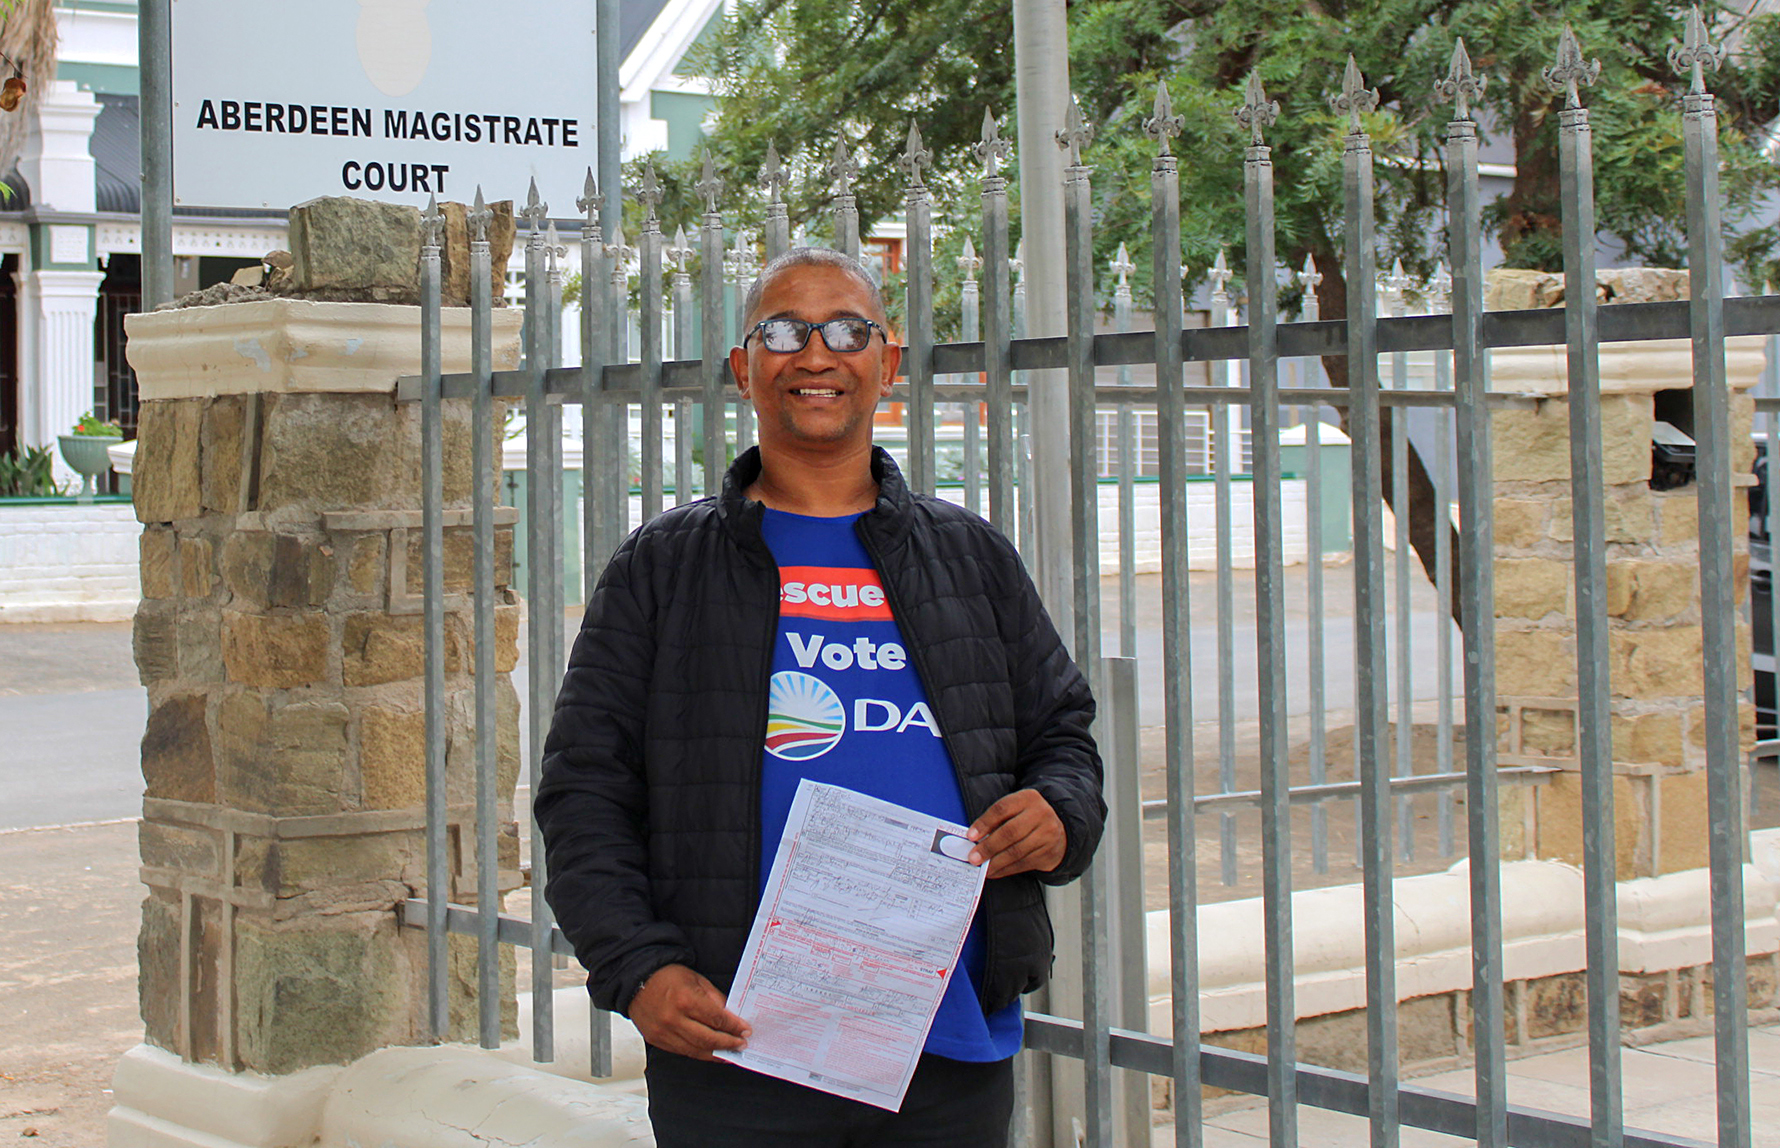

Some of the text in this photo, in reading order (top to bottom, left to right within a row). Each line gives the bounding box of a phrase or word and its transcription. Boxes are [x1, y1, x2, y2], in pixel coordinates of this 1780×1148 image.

[196, 99, 579, 147] ABERDEEN MAGISTRATE
[342, 160, 449, 193] COURT
[780, 582, 885, 608] scue
[785, 632, 907, 671] Vote
[854, 698, 943, 738] DA
